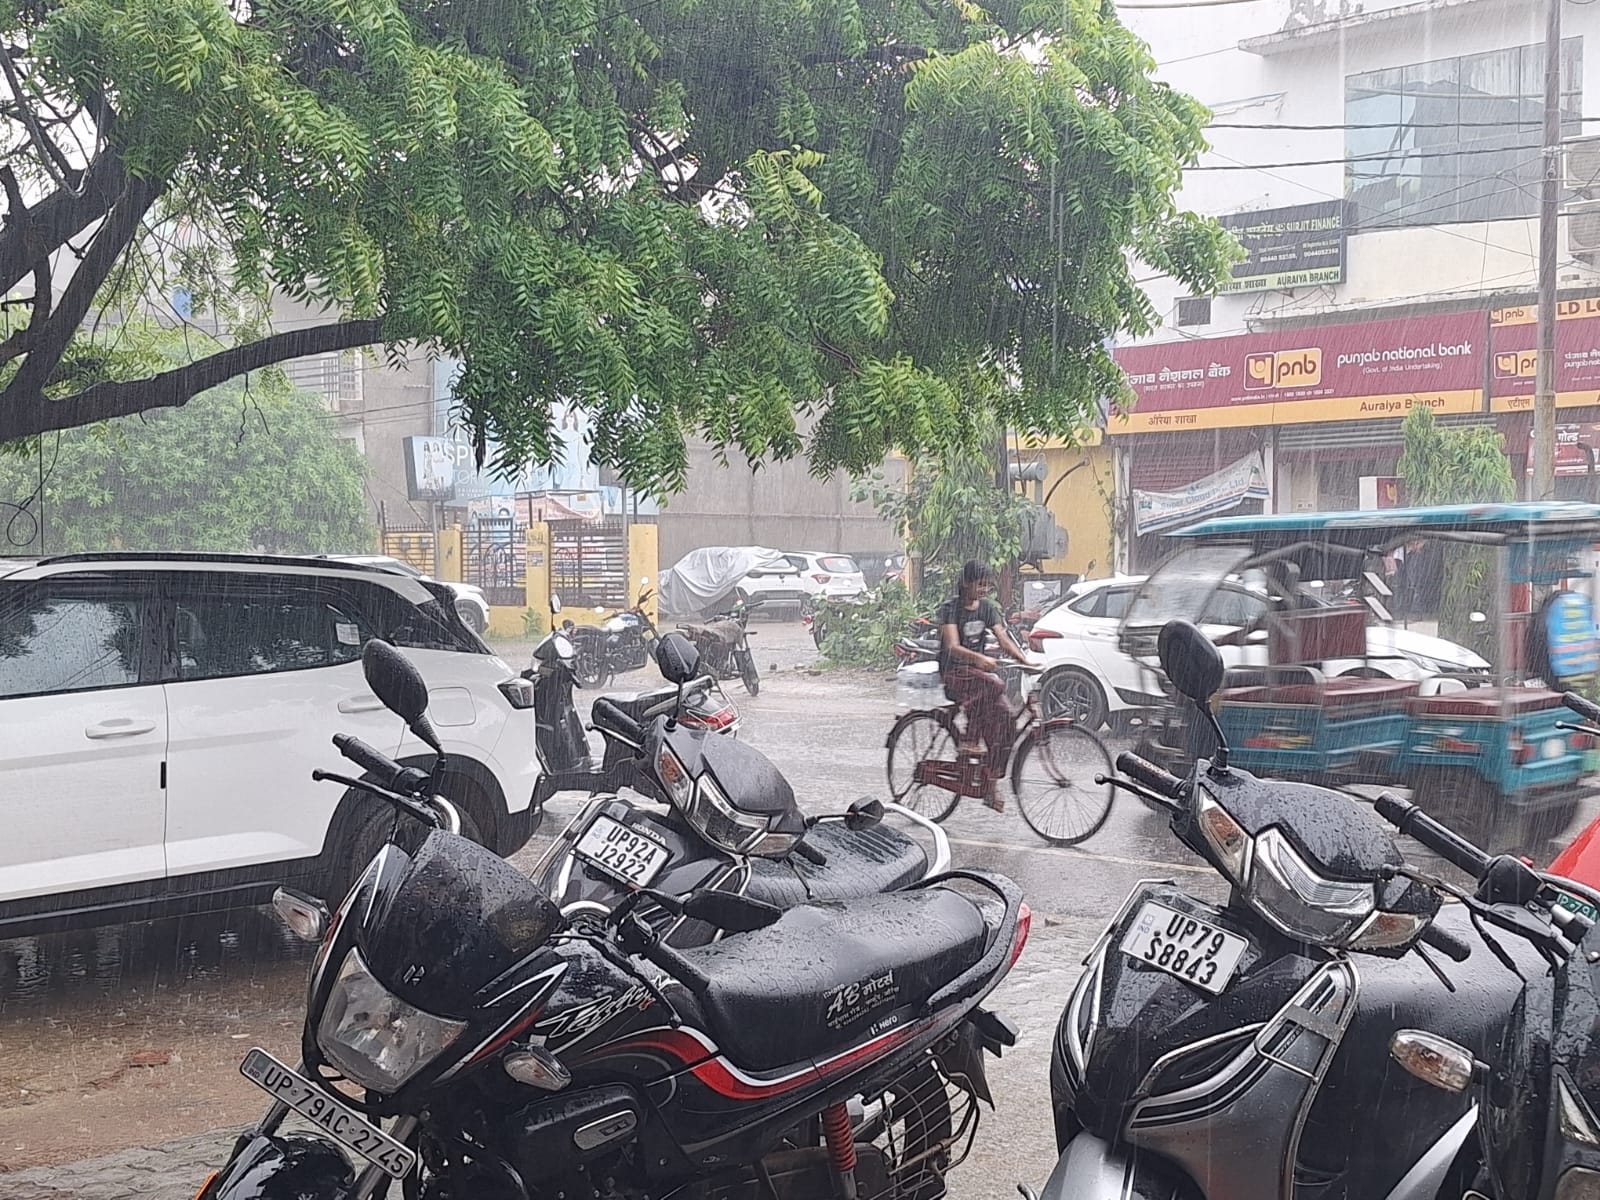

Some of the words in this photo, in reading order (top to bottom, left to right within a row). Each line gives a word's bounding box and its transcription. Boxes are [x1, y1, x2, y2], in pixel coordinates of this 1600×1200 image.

[1310, 215, 1340, 230] FINANCE
[1277, 273, 1308, 286] AURAIYA
[1309, 270, 1339, 283] BRANCH
[1505, 308, 1524, 321] pnb
[1337, 348, 1381, 368] punjab
[1382, 343, 1436, 361] national
[1438, 340, 1472, 356] bank
[1277, 353, 1317, 383] pnb
[1389, 363, 1404, 372] India
[1359, 401, 1402, 413] Auraiya
[1174, 414, 1197, 425] शाखा
[632, 823, 666, 846] HONDA
[606, 826, 657, 865] UP92A
[594, 844, 646, 881] J2922
[1166, 914, 1225, 959] UP79
[1144, 937, 1218, 985] S8843
[879, 1014, 898, 1031] Hero
